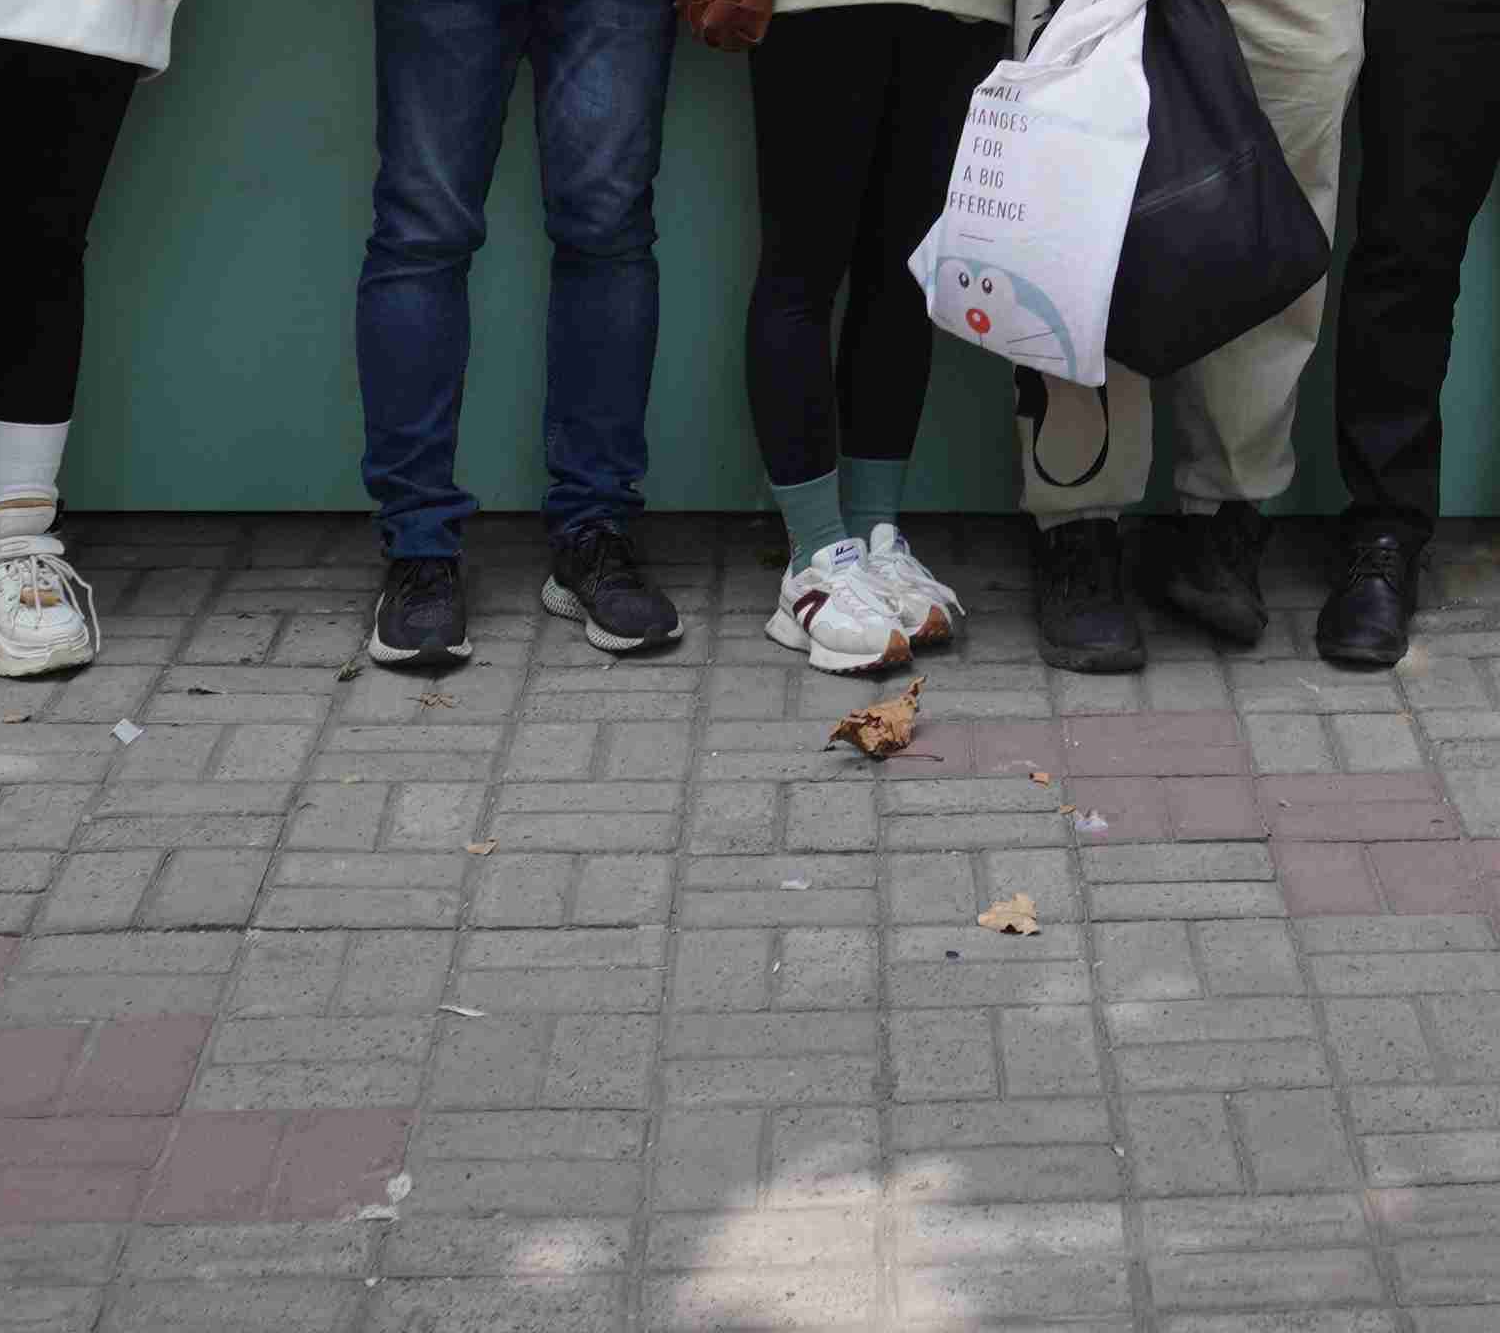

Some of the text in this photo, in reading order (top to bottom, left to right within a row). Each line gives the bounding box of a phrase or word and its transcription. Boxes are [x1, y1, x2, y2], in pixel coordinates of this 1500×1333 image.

[972, 135, 1003, 158] FOR
[963, 164, 1004, 190] A BIG
